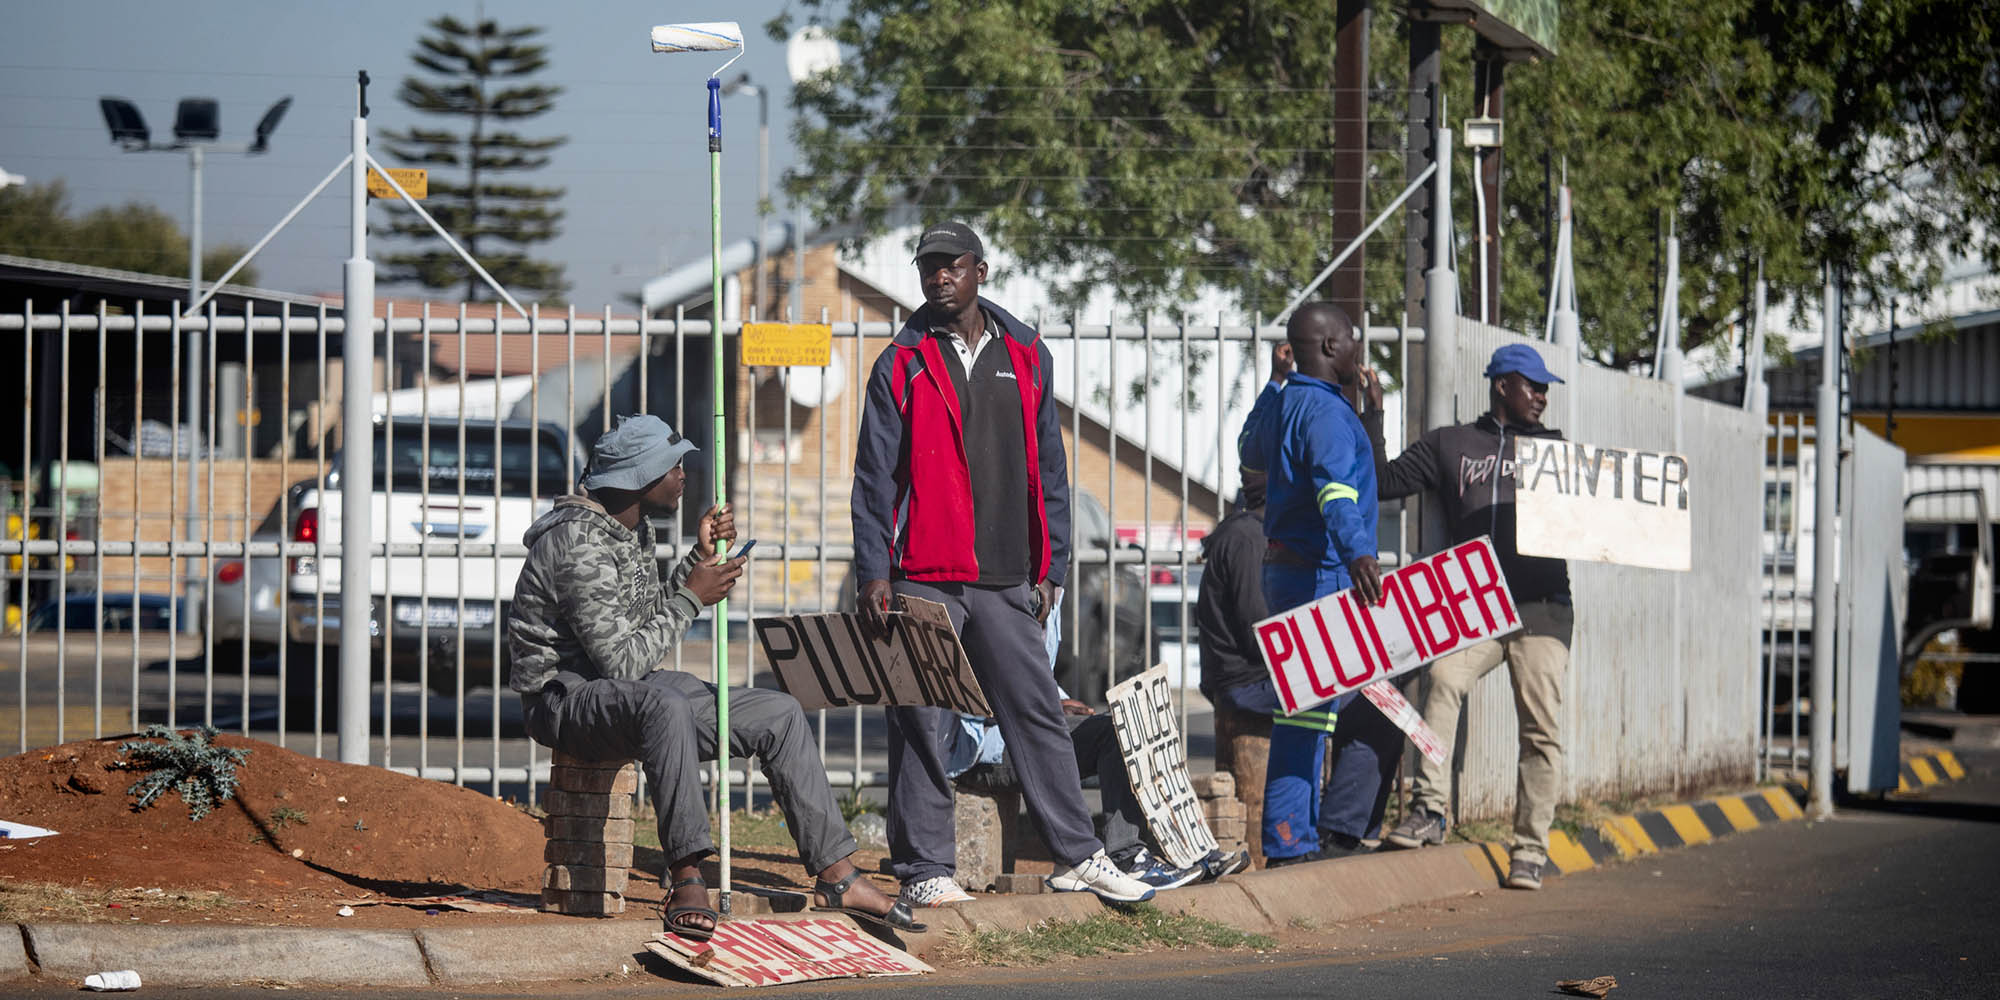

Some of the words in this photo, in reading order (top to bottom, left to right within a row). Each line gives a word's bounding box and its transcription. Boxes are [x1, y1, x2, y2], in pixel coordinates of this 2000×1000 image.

[1514, 438, 1688, 510] PAINTER
[748, 612, 993, 717] PLUMBER
[1257, 540, 1518, 714] PLUMBER
[1110, 675, 1179, 757] BUILDER
